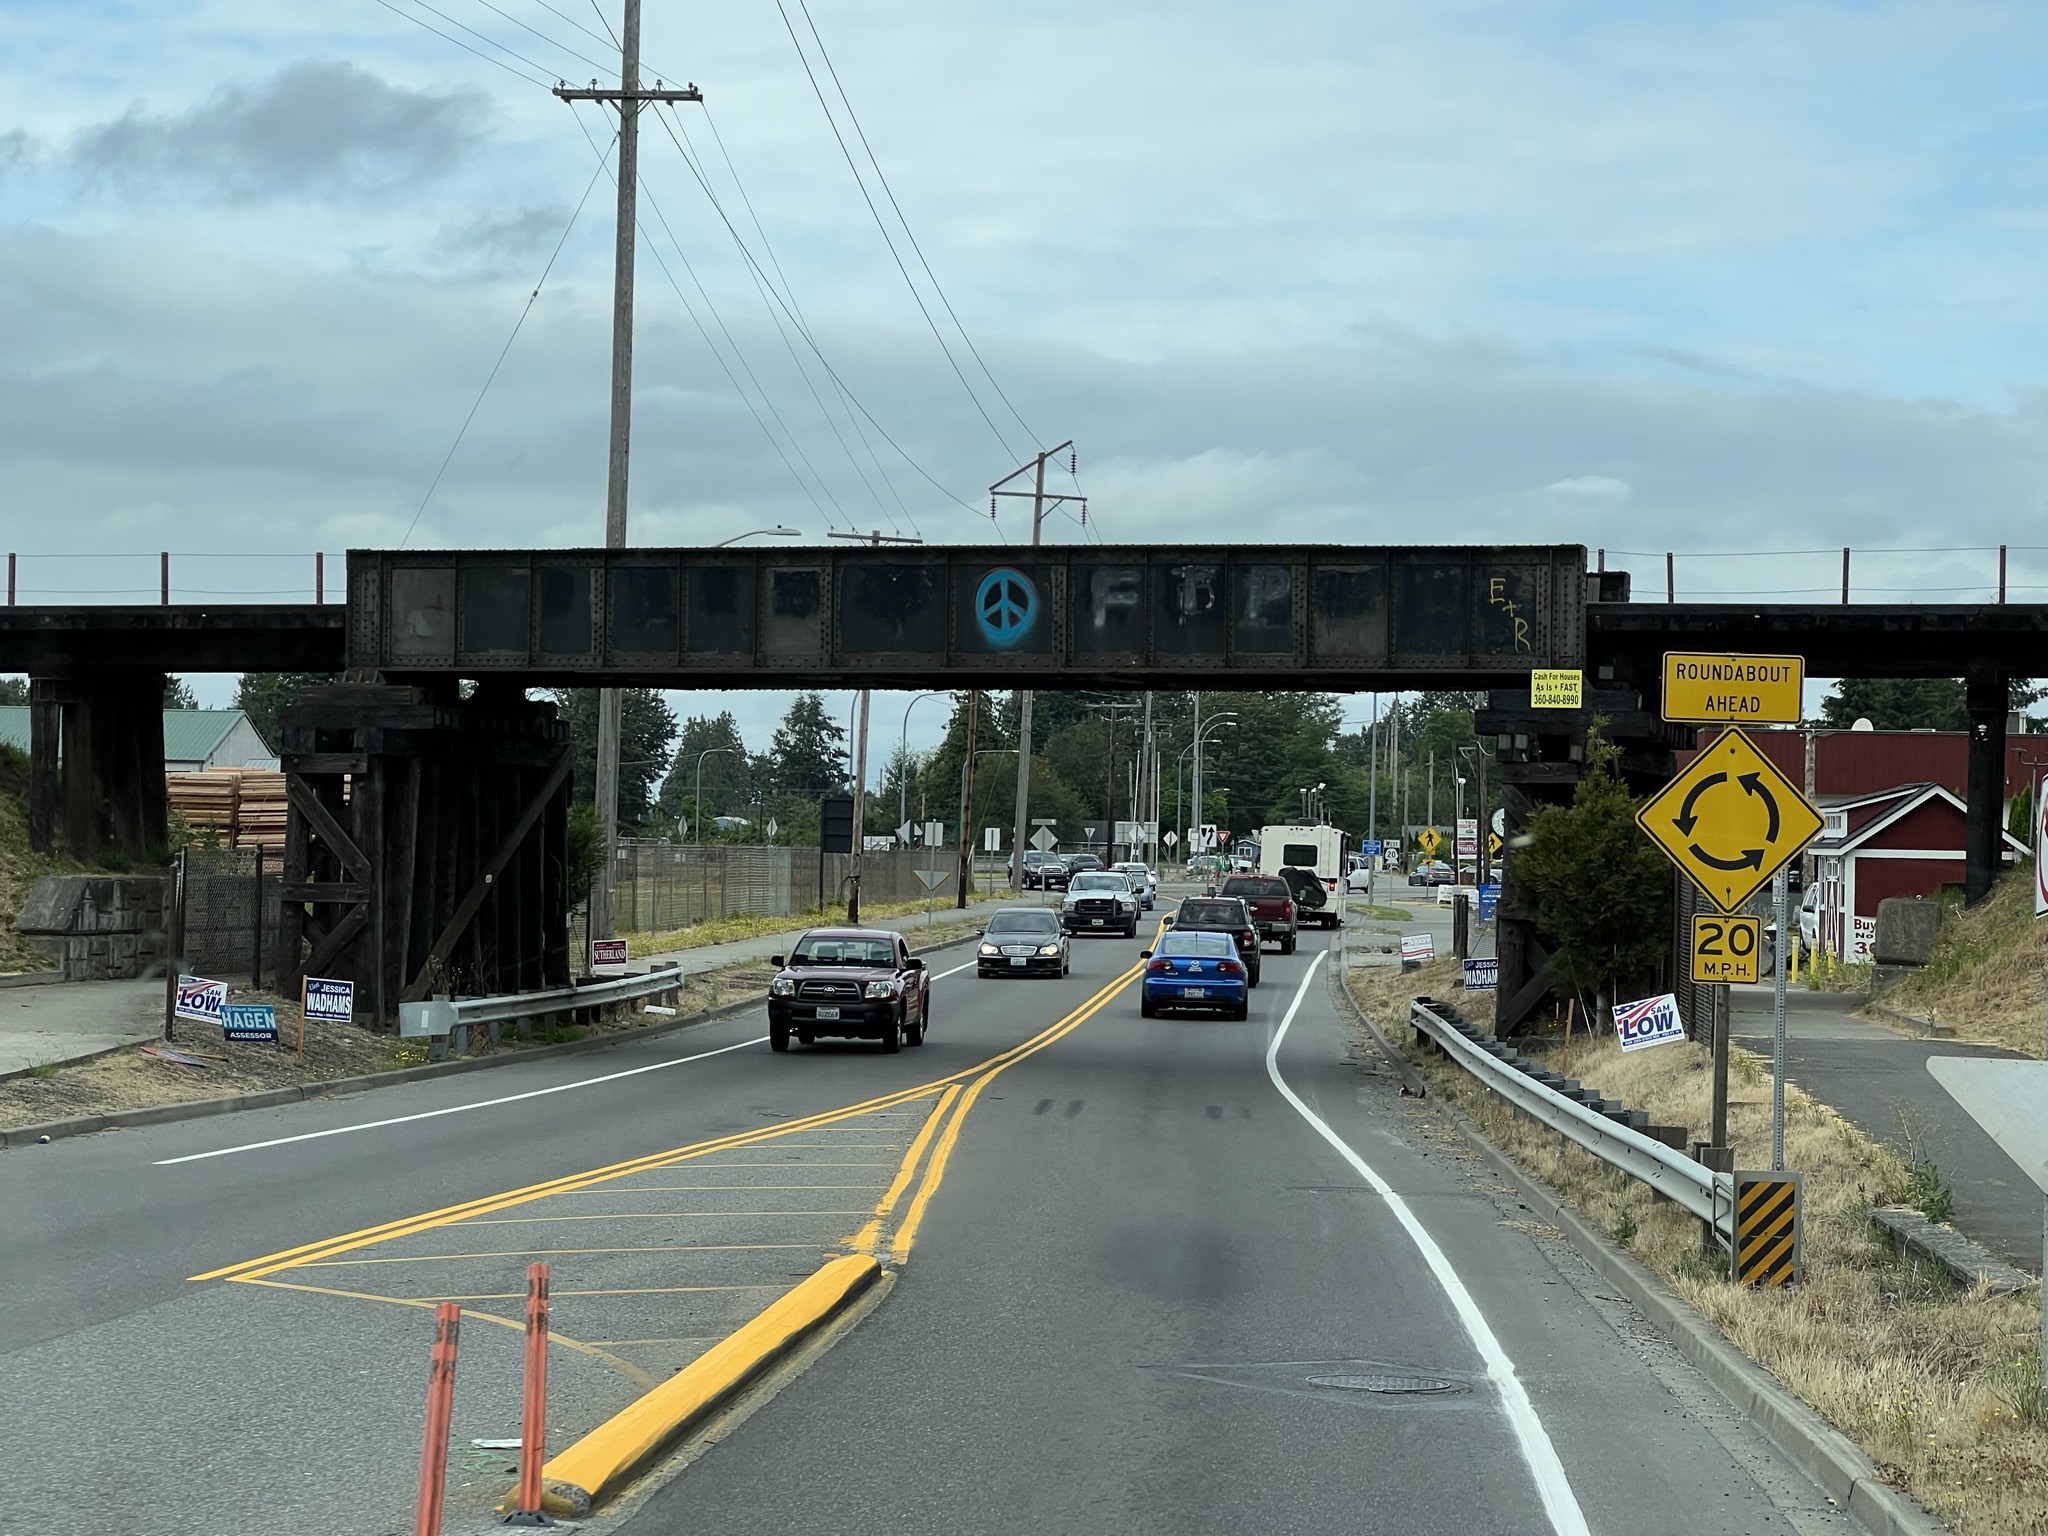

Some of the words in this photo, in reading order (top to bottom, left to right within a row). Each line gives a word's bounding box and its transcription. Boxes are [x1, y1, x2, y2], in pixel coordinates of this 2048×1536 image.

[1490, 578, 1506, 604] E
[1514, 617, 1532, 653] R
[1533, 672, 1548, 680] Cash
[1549, 672, 1558, 680] For
[1559, 672, 1580, 681] Houses
[1676, 663, 1791, 683] ROUNDABOUT
[1535, 682, 1545, 691] As
[1546, 683, 1553, 691] Is
[1533, 694, 1579, 705] 360-840-8990
[1704, 695, 1760, 713] AHEAD
[1697, 922, 1755, 957] 20
[1464, 968, 1498, 985] WADHAM
[1704, 962, 1751, 977] M.P.H.
[205, 988, 222, 996] SAM
[321, 983, 350, 994] JESSICA
[179, 988, 222, 1012] LOW
[307, 992, 351, 1014] WADHAMS
[1650, 1003, 1671, 1015] SAM
[221, 1011, 277, 1029] HAGEN
[1622, 1010, 1674, 1040] LOW
[230, 1031, 272, 1039] ASSESSOR
